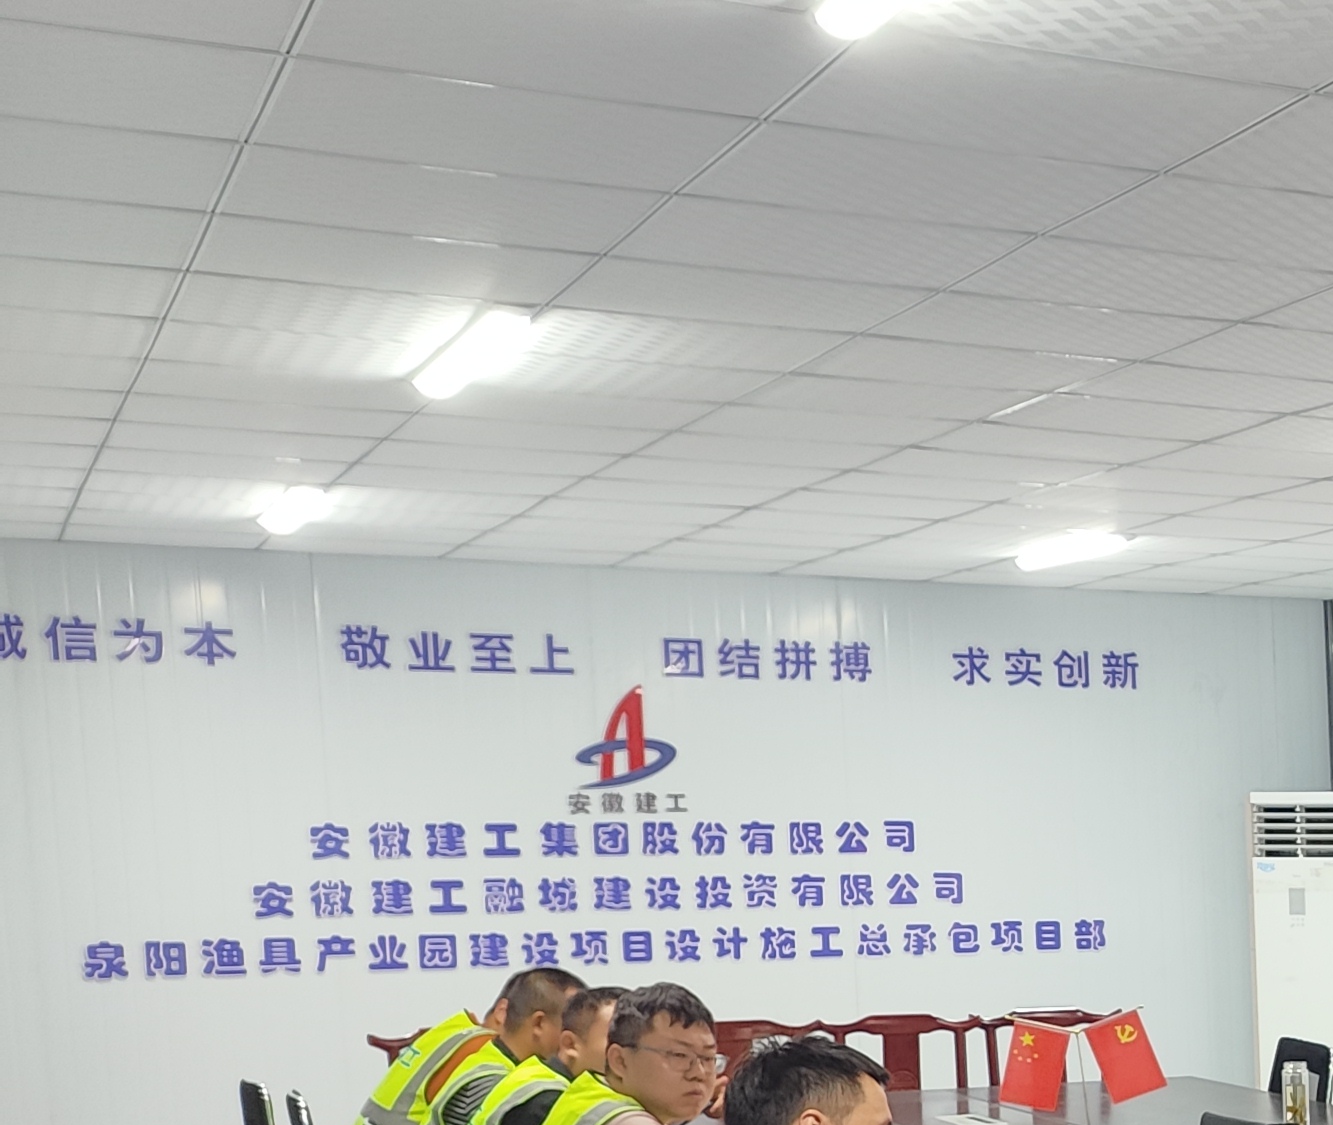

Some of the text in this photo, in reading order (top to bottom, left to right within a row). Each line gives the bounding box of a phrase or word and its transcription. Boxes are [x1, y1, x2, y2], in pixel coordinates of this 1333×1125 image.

[341, 624, 576, 676] 敬业至上
[662, 636, 873, 683] 团结拼搏
[951, 646, 1140, 690] 求实创新
[567, 791, 689, 815] 安徽建工
[309, 820, 917, 860] 安徽建工集团股份有限公司
[251, 872, 965, 918] 安徽建工融城建设投资有限公司
[83, 919, 1107, 979] 泉阳渔具产业园建设项目设计施工总承包项目部
